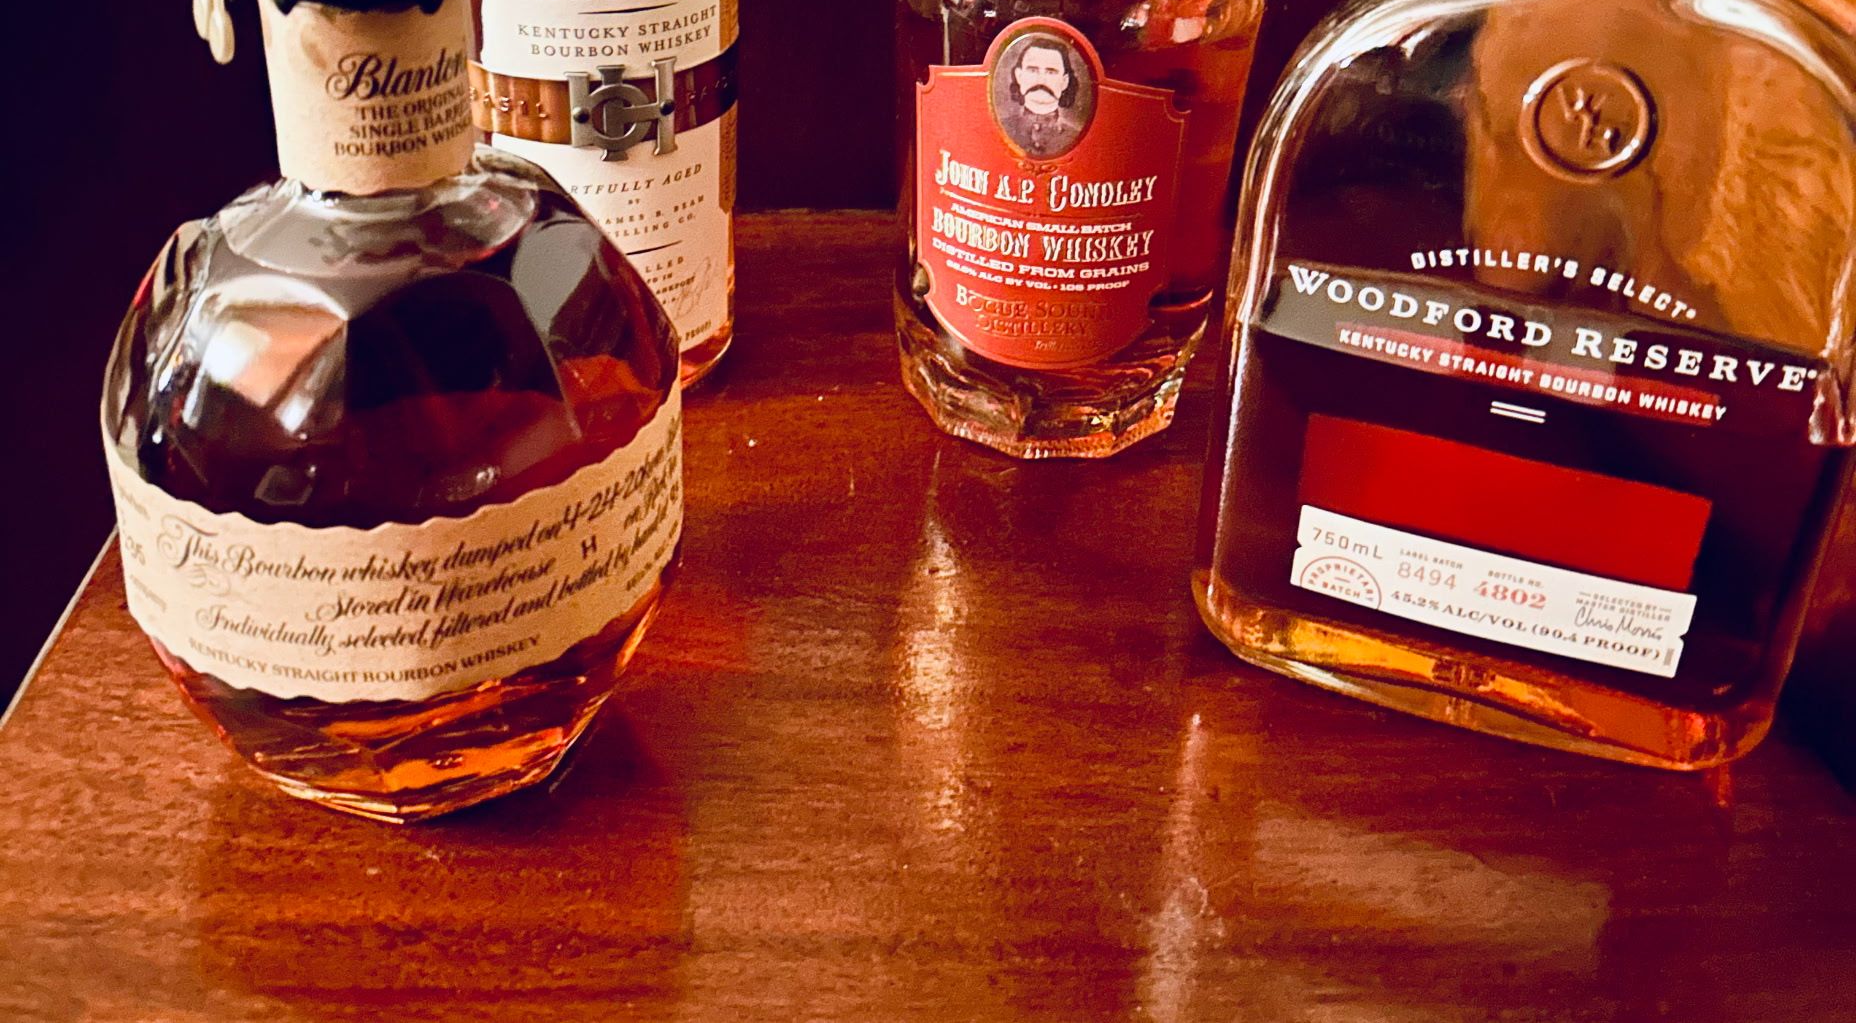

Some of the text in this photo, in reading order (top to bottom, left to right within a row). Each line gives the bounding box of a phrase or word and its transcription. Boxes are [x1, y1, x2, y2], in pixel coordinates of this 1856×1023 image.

[517, 4, 717, 40] KENTUCKY STRAIGHT
[531, 24, 712, 58] BOURBON WHISKEY
[350, 117, 421, 139] SINGLE
[355, 104, 399, 120] THE
[335, 135, 427, 158] BOURBON
[570, 164, 702, 195] RTFULLY AGED
[934, 149, 990, 196] JOHN
[598, 213, 645, 225] AMES
[673, 195, 704, 213] BEAM
[951, 202, 1132, 234] AMERICAN SMALL BATCH
[931, 207, 1154, 263] BOURBON WHISKEY
[932, 237, 1150, 279] DISTILLED FROM GRAINS
[1410, 248, 1579, 279] DISTILLER'S
[978, 271, 1003, 283] ALC
[1005, 277, 1023, 287] BY
[1025, 280, 1051, 290] VOL
[1087, 280, 1130, 291] PROOF
[955, 284, 1029, 320] BOGUE
[1288, 264, 1552, 347] WOODFORD
[1339, 328, 1727, 421] KENTUCKY STRAIGHT BOURBON WHISKEY
[222, 543, 337, 584] Bourbon
[343, 550, 442, 586] whiskey
[443, 519, 540, 570] dumped
[581, 534, 597, 559] H
[1312, 527, 1383, 560] 750mL
[1308, 563, 1374, 602] PROPRIETARY
[1322, 582, 1361, 598] BATCH
[1397, 561, 1457, 590] 8494
[1488, 570, 1524, 584] BOTTLE
[304, 585, 408, 622] Stored
[407, 589, 430, 611] in
[1473, 580, 1547, 610] 4802
[195, 604, 336, 656] Individually
[430, 596, 515, 649] filtered
[512, 580, 558, 617] and
[1390, 590, 1661, 661] 45.2% ALC/VOL (90.4 PROOF)
[189, 634, 540, 685] KENTUCKY STRAIGHT BOURBON WHISKEY
